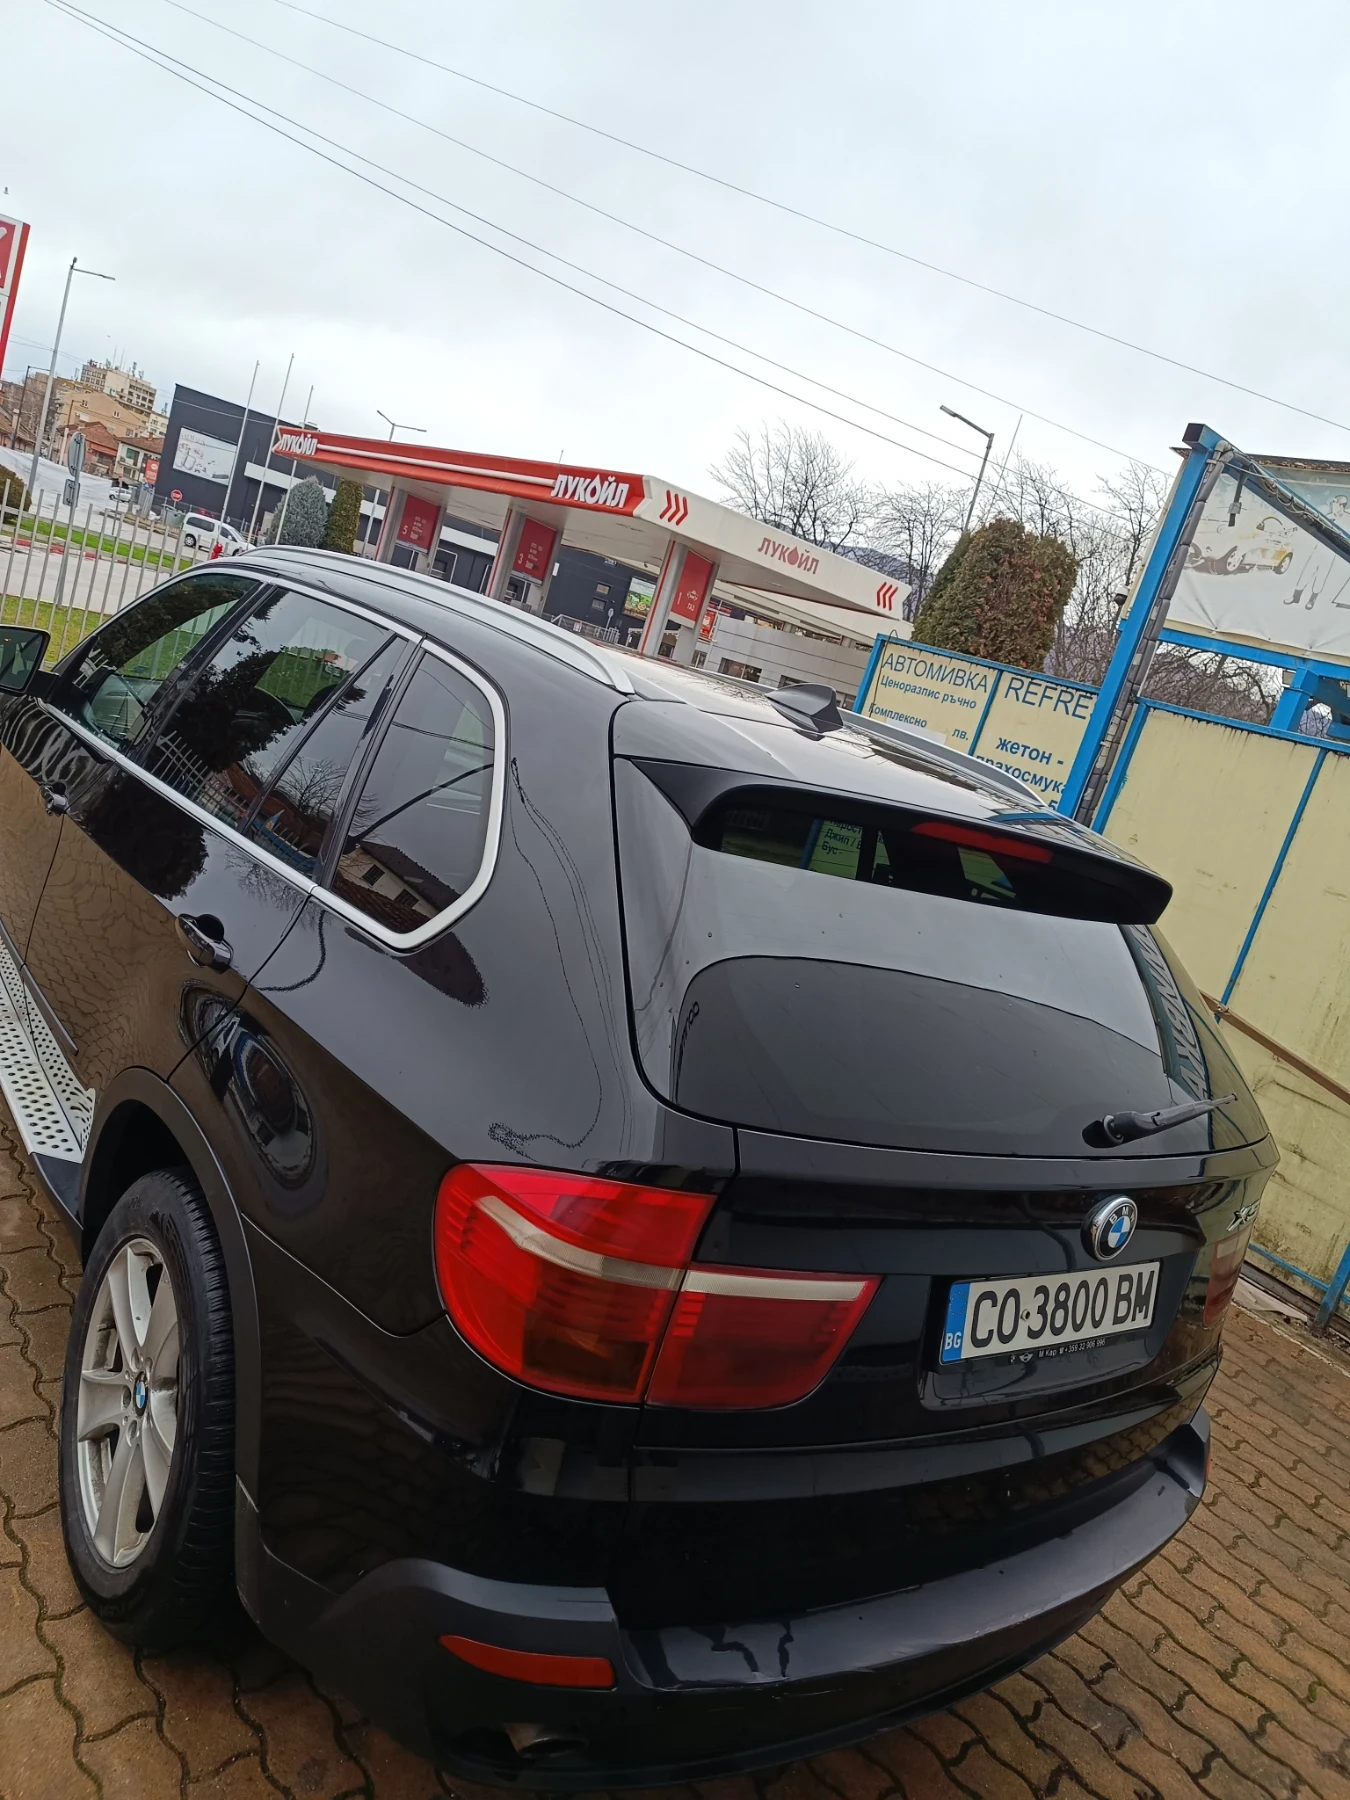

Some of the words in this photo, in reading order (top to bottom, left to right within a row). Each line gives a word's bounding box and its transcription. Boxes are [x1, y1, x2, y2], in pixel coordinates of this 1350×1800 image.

[280, 432, 318, 456] ЛУКОЙЛ
[550, 474, 630, 508] ЛУКОЙЛ
[402, 525, 409, 535] 5
[517, 552, 524, 565] 3
[757, 537, 820, 575] ЛУКОЙЛ
[881, 653, 988, 694] АВТОМИВКА
[880, 675, 941, 700] Ценоразпис
[941, 693, 977, 709] ръчно
[868, 702, 928, 728] Комплексно
[952, 728, 969, 741] лв.
[995, 737, 1053, 765] жетон
[976, 755, 1066, 794] ахосмук
[821, 841, 838, 855] Бус
[1109, 1206, 1135, 1224] BMW
[944, 1332, 961, 1350] BG
